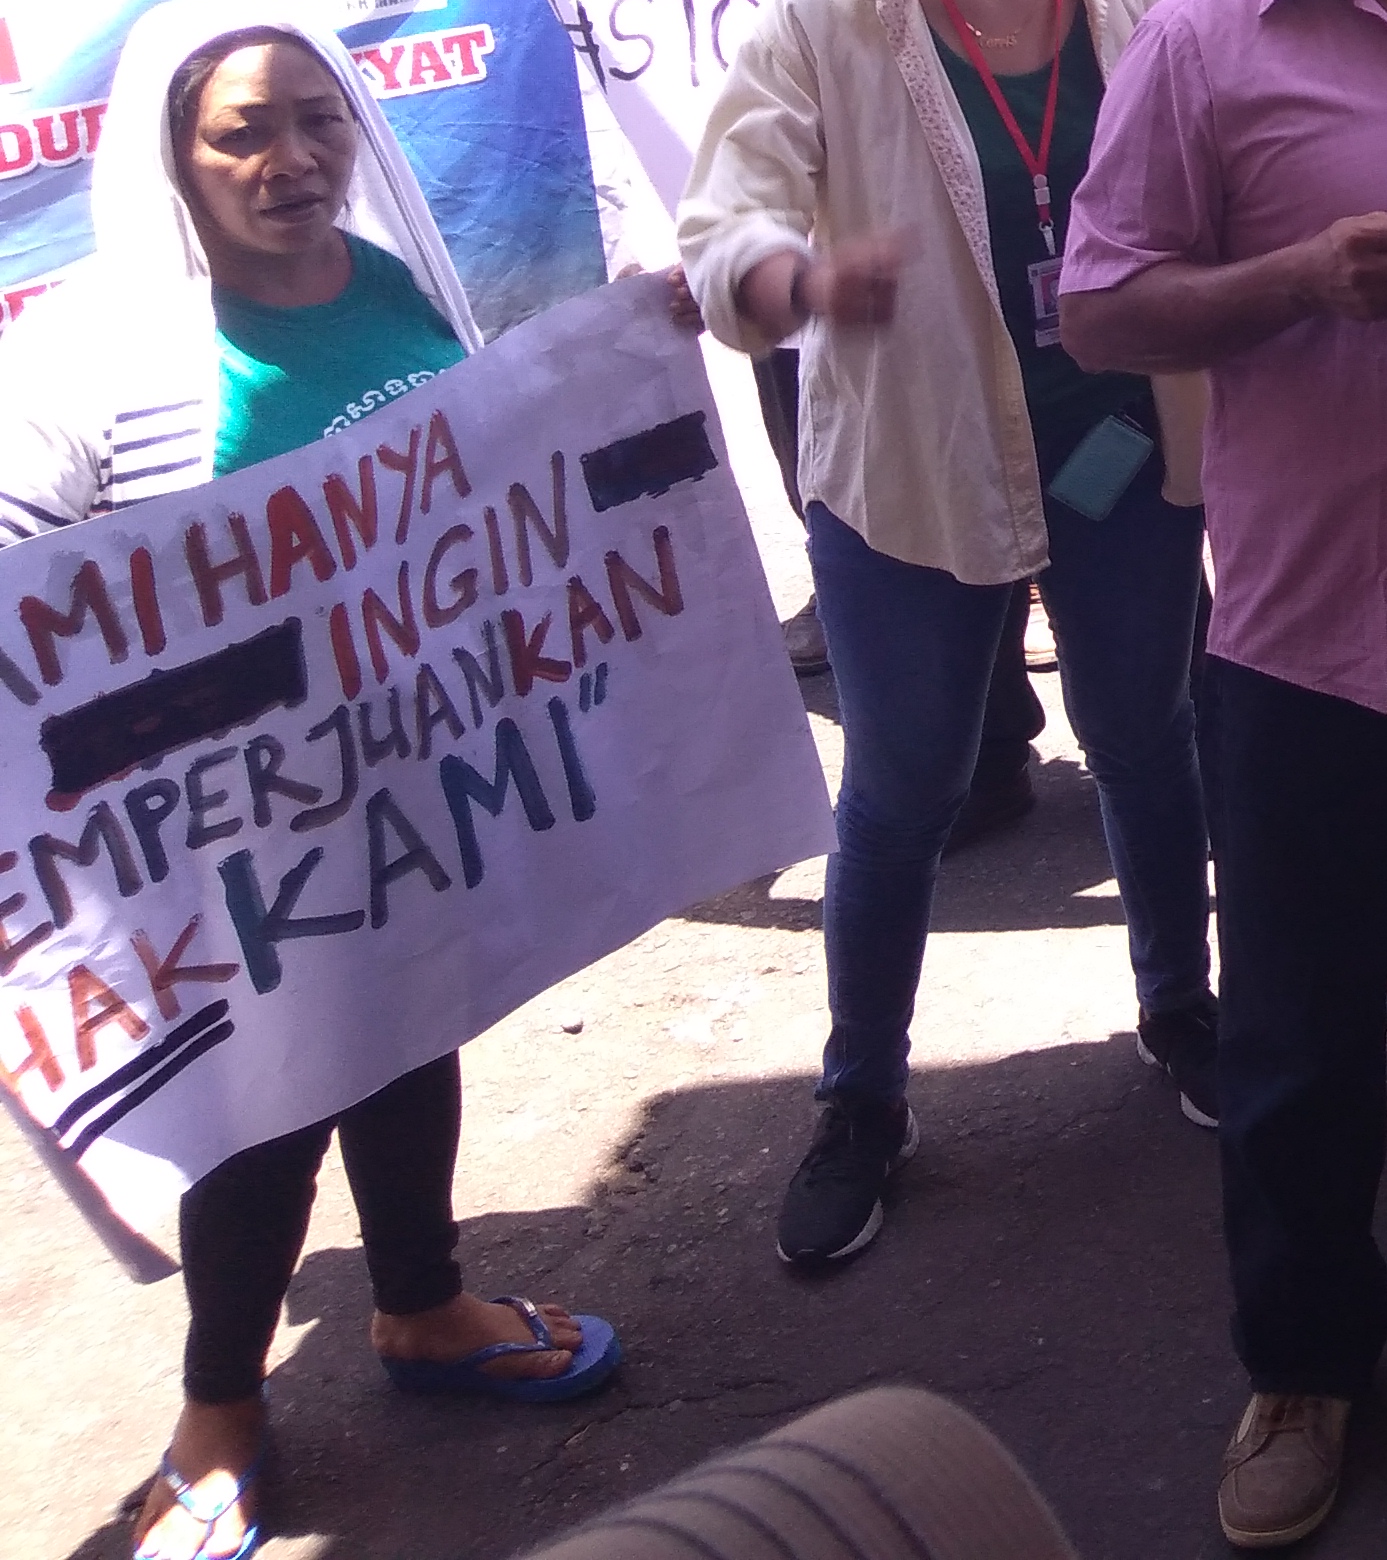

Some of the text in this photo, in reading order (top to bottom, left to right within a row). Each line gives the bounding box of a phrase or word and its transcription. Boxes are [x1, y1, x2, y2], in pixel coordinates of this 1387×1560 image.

[181, 407, 473, 629] HANYA
[328, 449, 570, 702] INGIN
[0, 523, 687, 977] EMPERJUANKAN
[2, 914, 240, 1093] HAK
